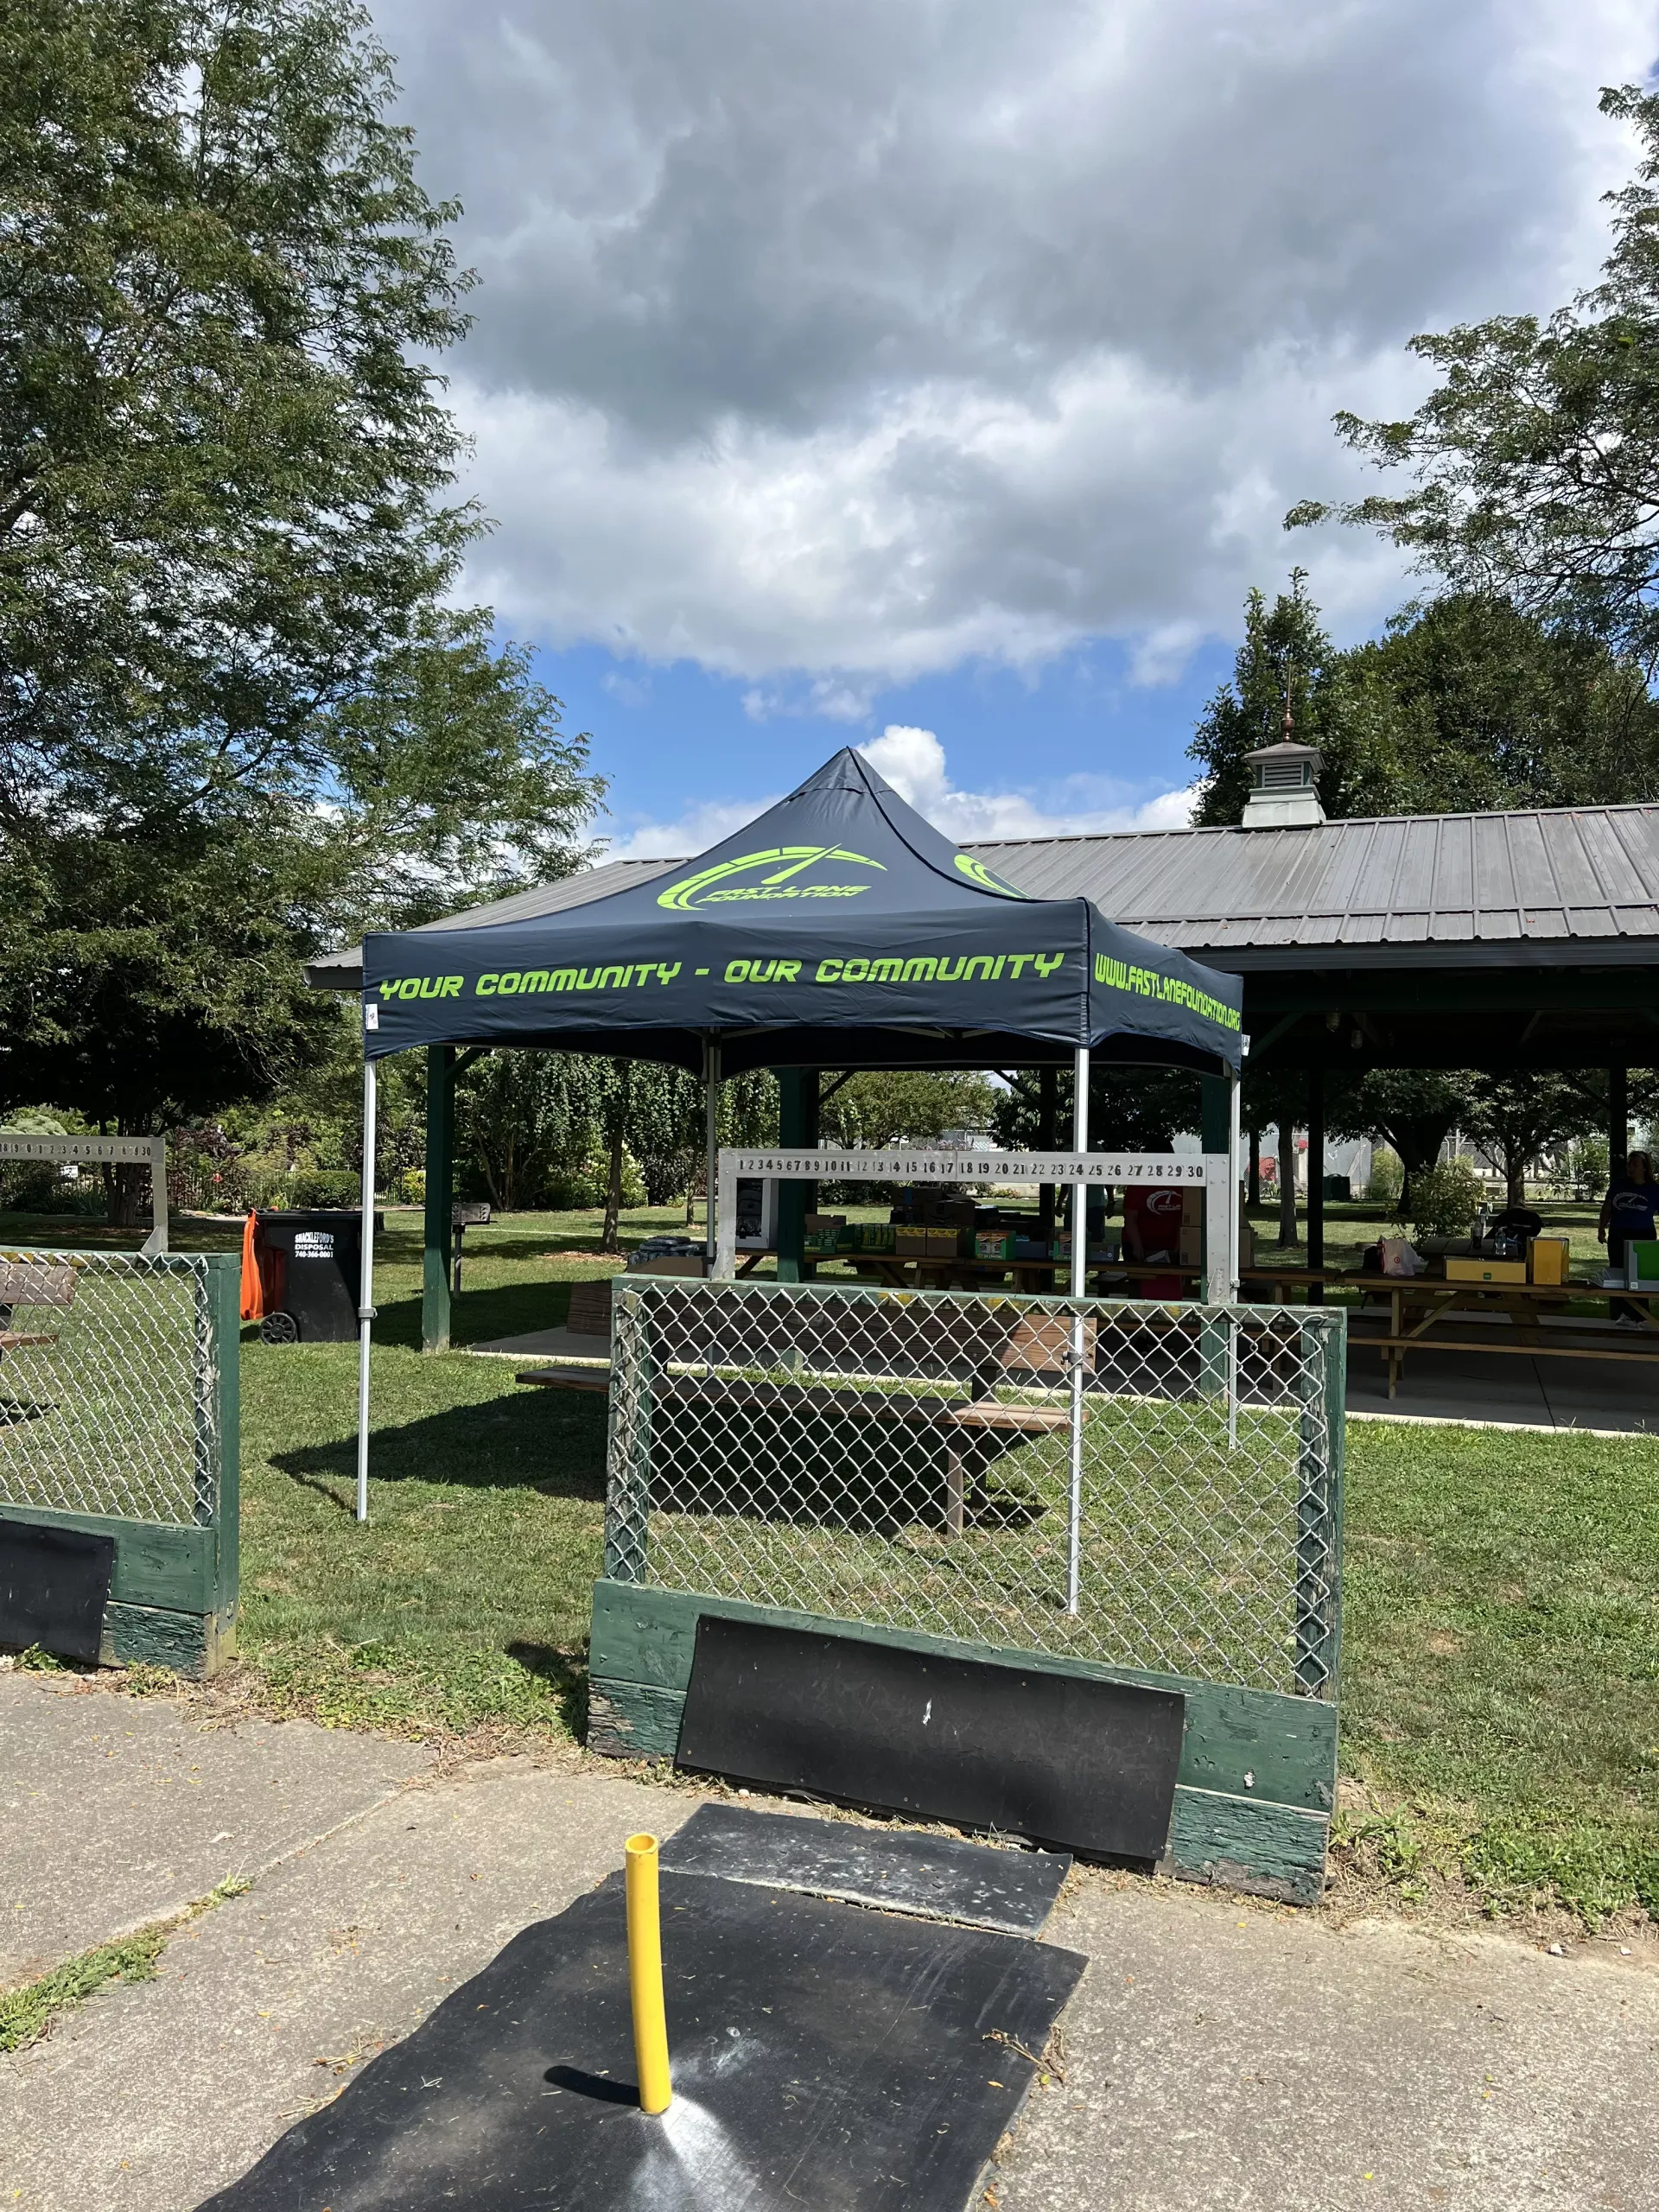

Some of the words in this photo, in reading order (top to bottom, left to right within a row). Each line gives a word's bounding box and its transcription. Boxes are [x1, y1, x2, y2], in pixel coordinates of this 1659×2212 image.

[694, 892, 859, 904] FOUNDATION
[706, 887, 781, 898] FAST
[378, 975, 464, 1001] YOUR
[475, 962, 682, 995] COMMUNITY
[724, 959, 802, 983] OUR
[816, 952, 1065, 982] COMMUNITY
[1094, 953, 1241, 1031] WWW.FASTLANEFOUNDATION.ORG
[142, 1146, 151, 1156] 30
[740, 1160, 744, 1170] 1
[748, 1160, 754, 1170] 2
[758, 1160, 764, 1170] 3
[766, 1160, 773, 1170] 4
[777, 1160, 783, 1170] 5
[786, 1160, 792, 1171] 6
[794, 1160, 801, 1171] 7
[804, 1160, 810, 1171] 8
[814, 1160, 820, 1171] 9
[825, 1160, 837, 1171] 10
[841, 1160, 851, 1172] 11
[857, 1161, 868, 1172] 12
[873, 1161, 884, 1172] 13
[889, 1161, 900, 1173] 14
[906, 1161, 918, 1173] 15
[924, 1161, 936, 1173] 16
[941, 1162, 954, 1173] 17
[961, 1162, 973, 1173] 18
[978, 1162, 989, 1174] 19
[995, 1163, 1009, 1174] 20
[1013, 1163, 1025, 1174] 21
[1031, 1163, 1045, 1175] 22
[1051, 1164, 1064, 1175] 23
[1069, 1164, 1084, 1175] 24
[1088, 1164, 1103, 1176] 25
[1108, 1164, 1122, 1176] 26
[1128, 1164, 1142, 1176] 27
[1147, 1165, 1163, 1177] 28
[1167, 1165, 1182, 1177] 29
[1187, 1166, 1204, 1178] 30
[295, 1231, 334, 1243] SHACKLEFORD'S
